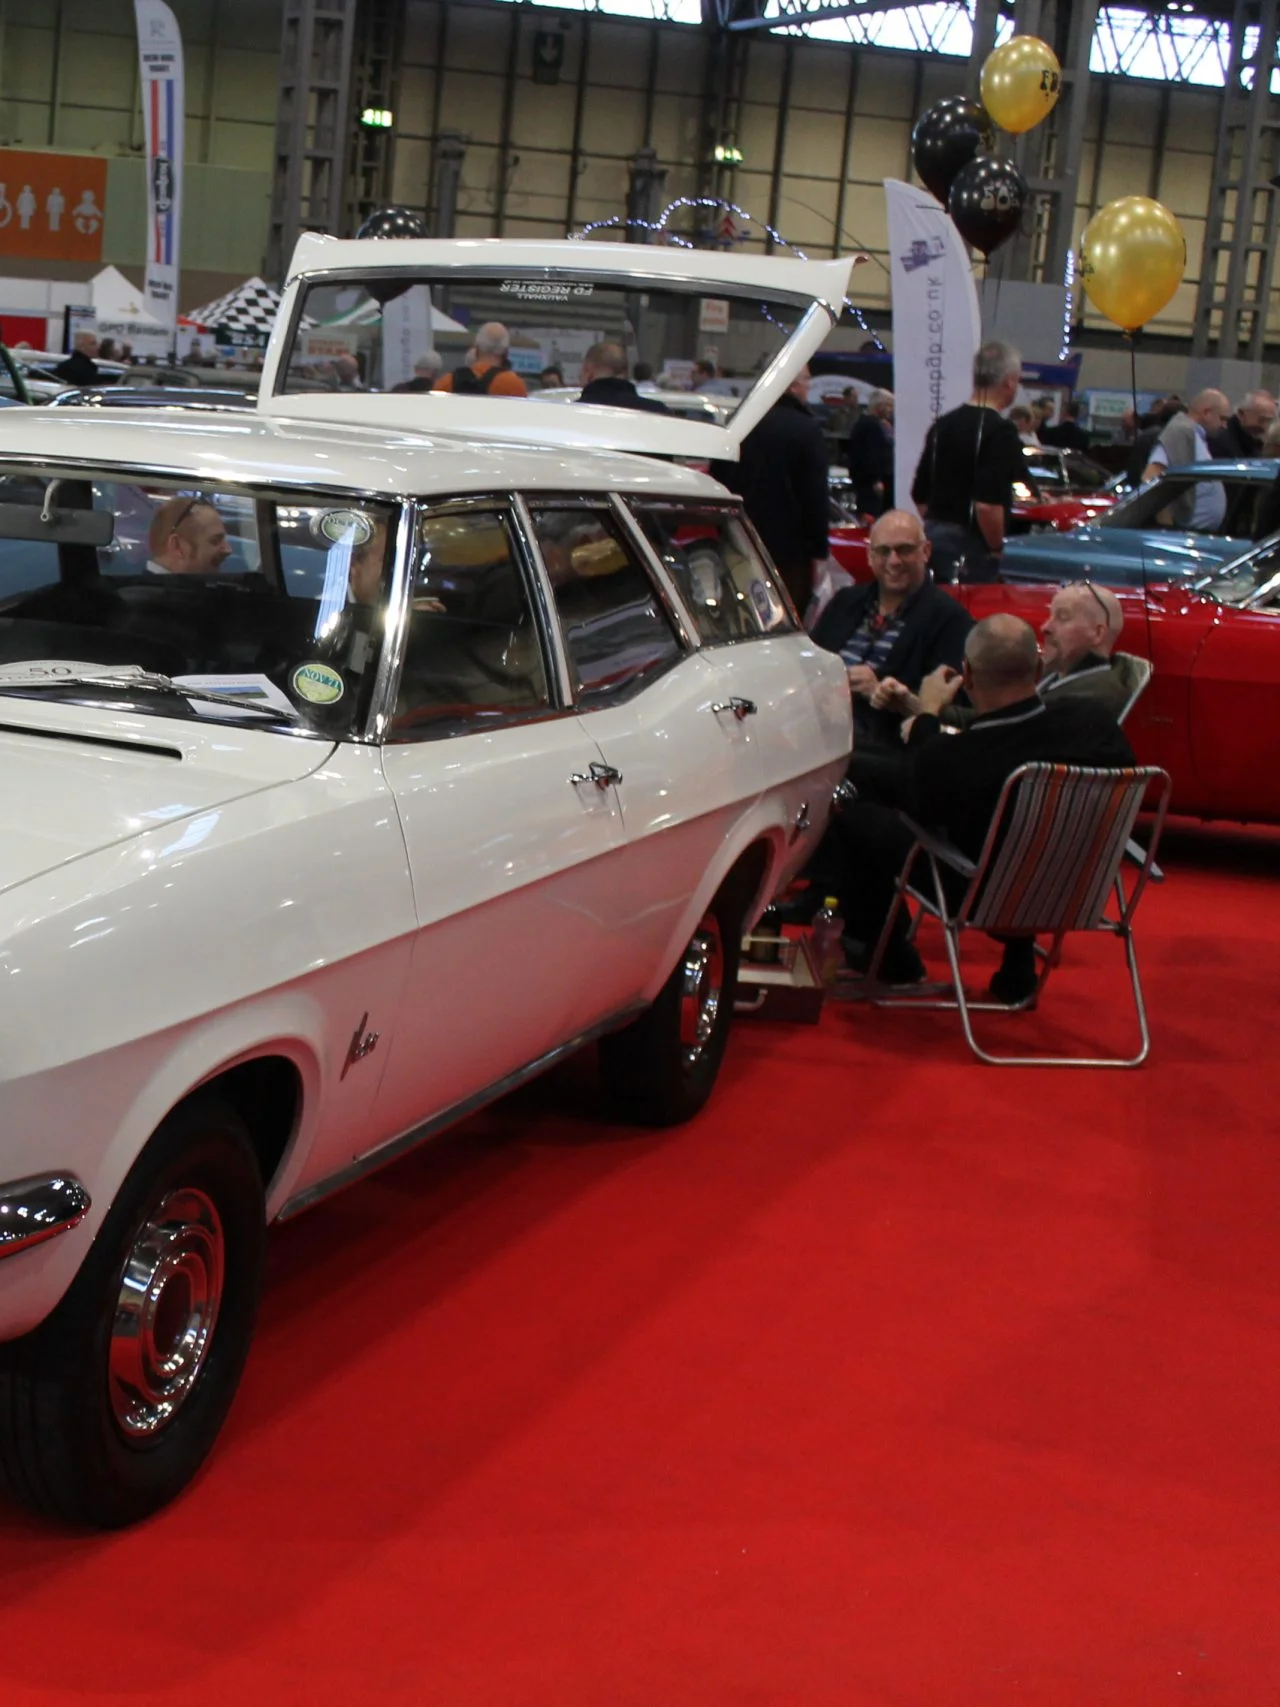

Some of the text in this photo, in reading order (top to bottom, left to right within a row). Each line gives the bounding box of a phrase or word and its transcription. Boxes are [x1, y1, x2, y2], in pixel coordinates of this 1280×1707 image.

[499, 283, 571, 295] REGISTER
[573, 286, 594, 296] FD
[516, 292, 569, 302] VAUXHALL
[29, 666, 72, 676] 50
